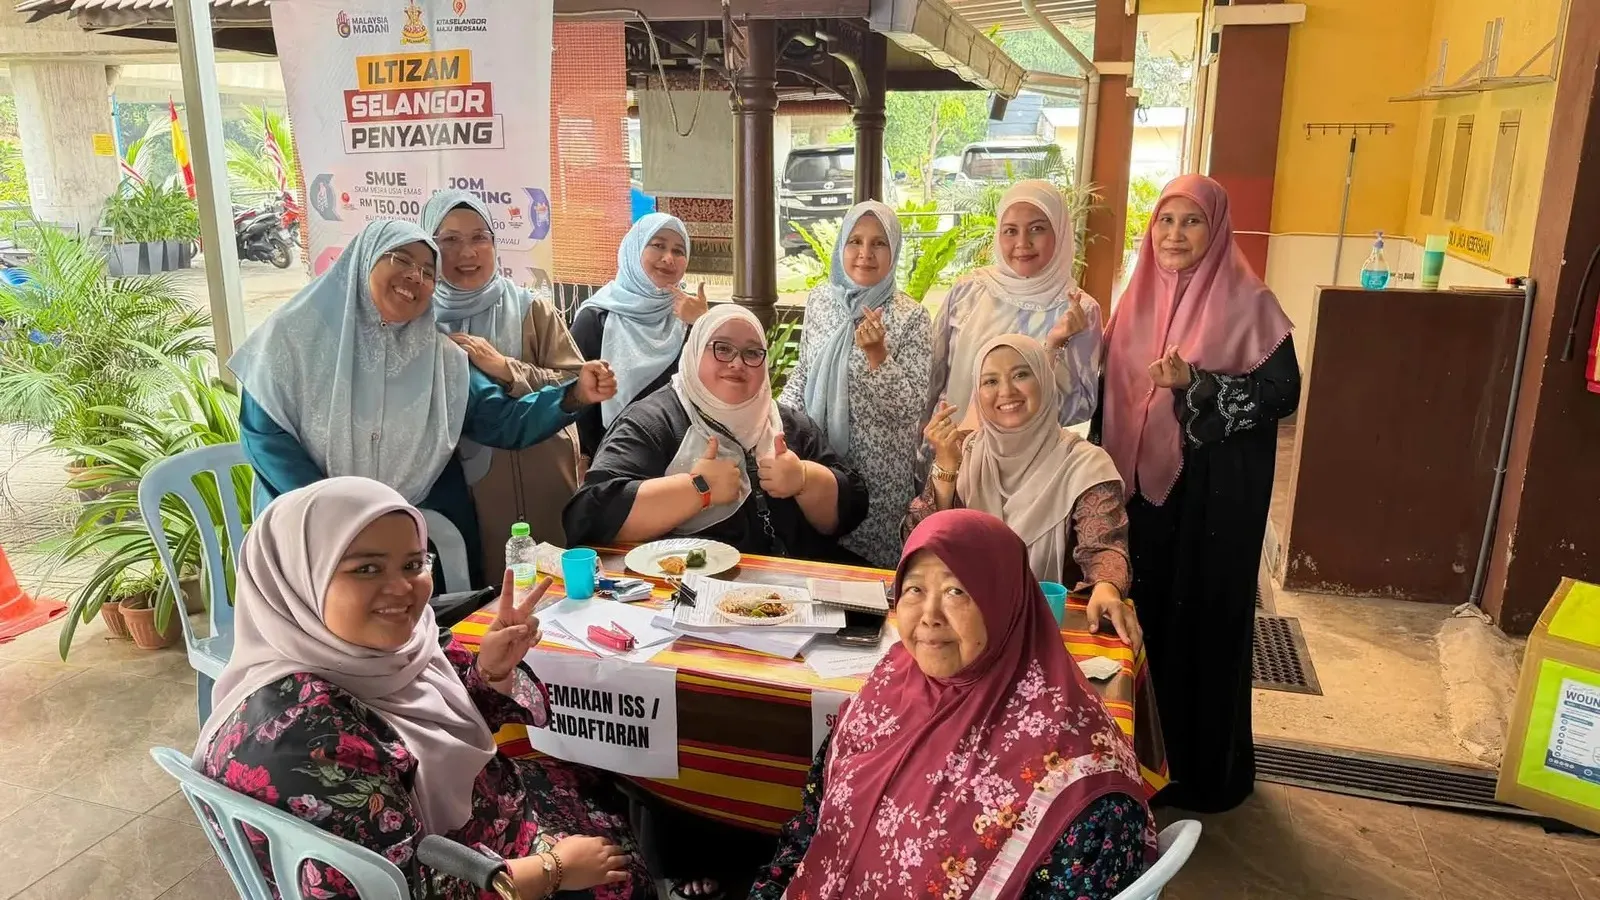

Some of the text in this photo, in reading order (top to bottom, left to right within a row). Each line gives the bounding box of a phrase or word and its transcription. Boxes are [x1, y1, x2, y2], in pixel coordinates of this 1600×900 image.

[352, 16, 389, 25] MALAYSIA
[353, 24, 390, 34] MADANI
[367, 56, 460, 85] ILTIZAM
[351, 89, 486, 118] SELANGOR
[351, 122, 493, 149] PENYAYANG
[365, 171, 407, 186] SMUE
[448, 177, 485, 190] JOM
[360, 198, 420, 215] RM 150.00
[545, 682, 660, 720] EMAKAN ISS /
[1566, 690, 1600, 708] WOUN
[549, 712, 650, 749] ENDAFTARAN
